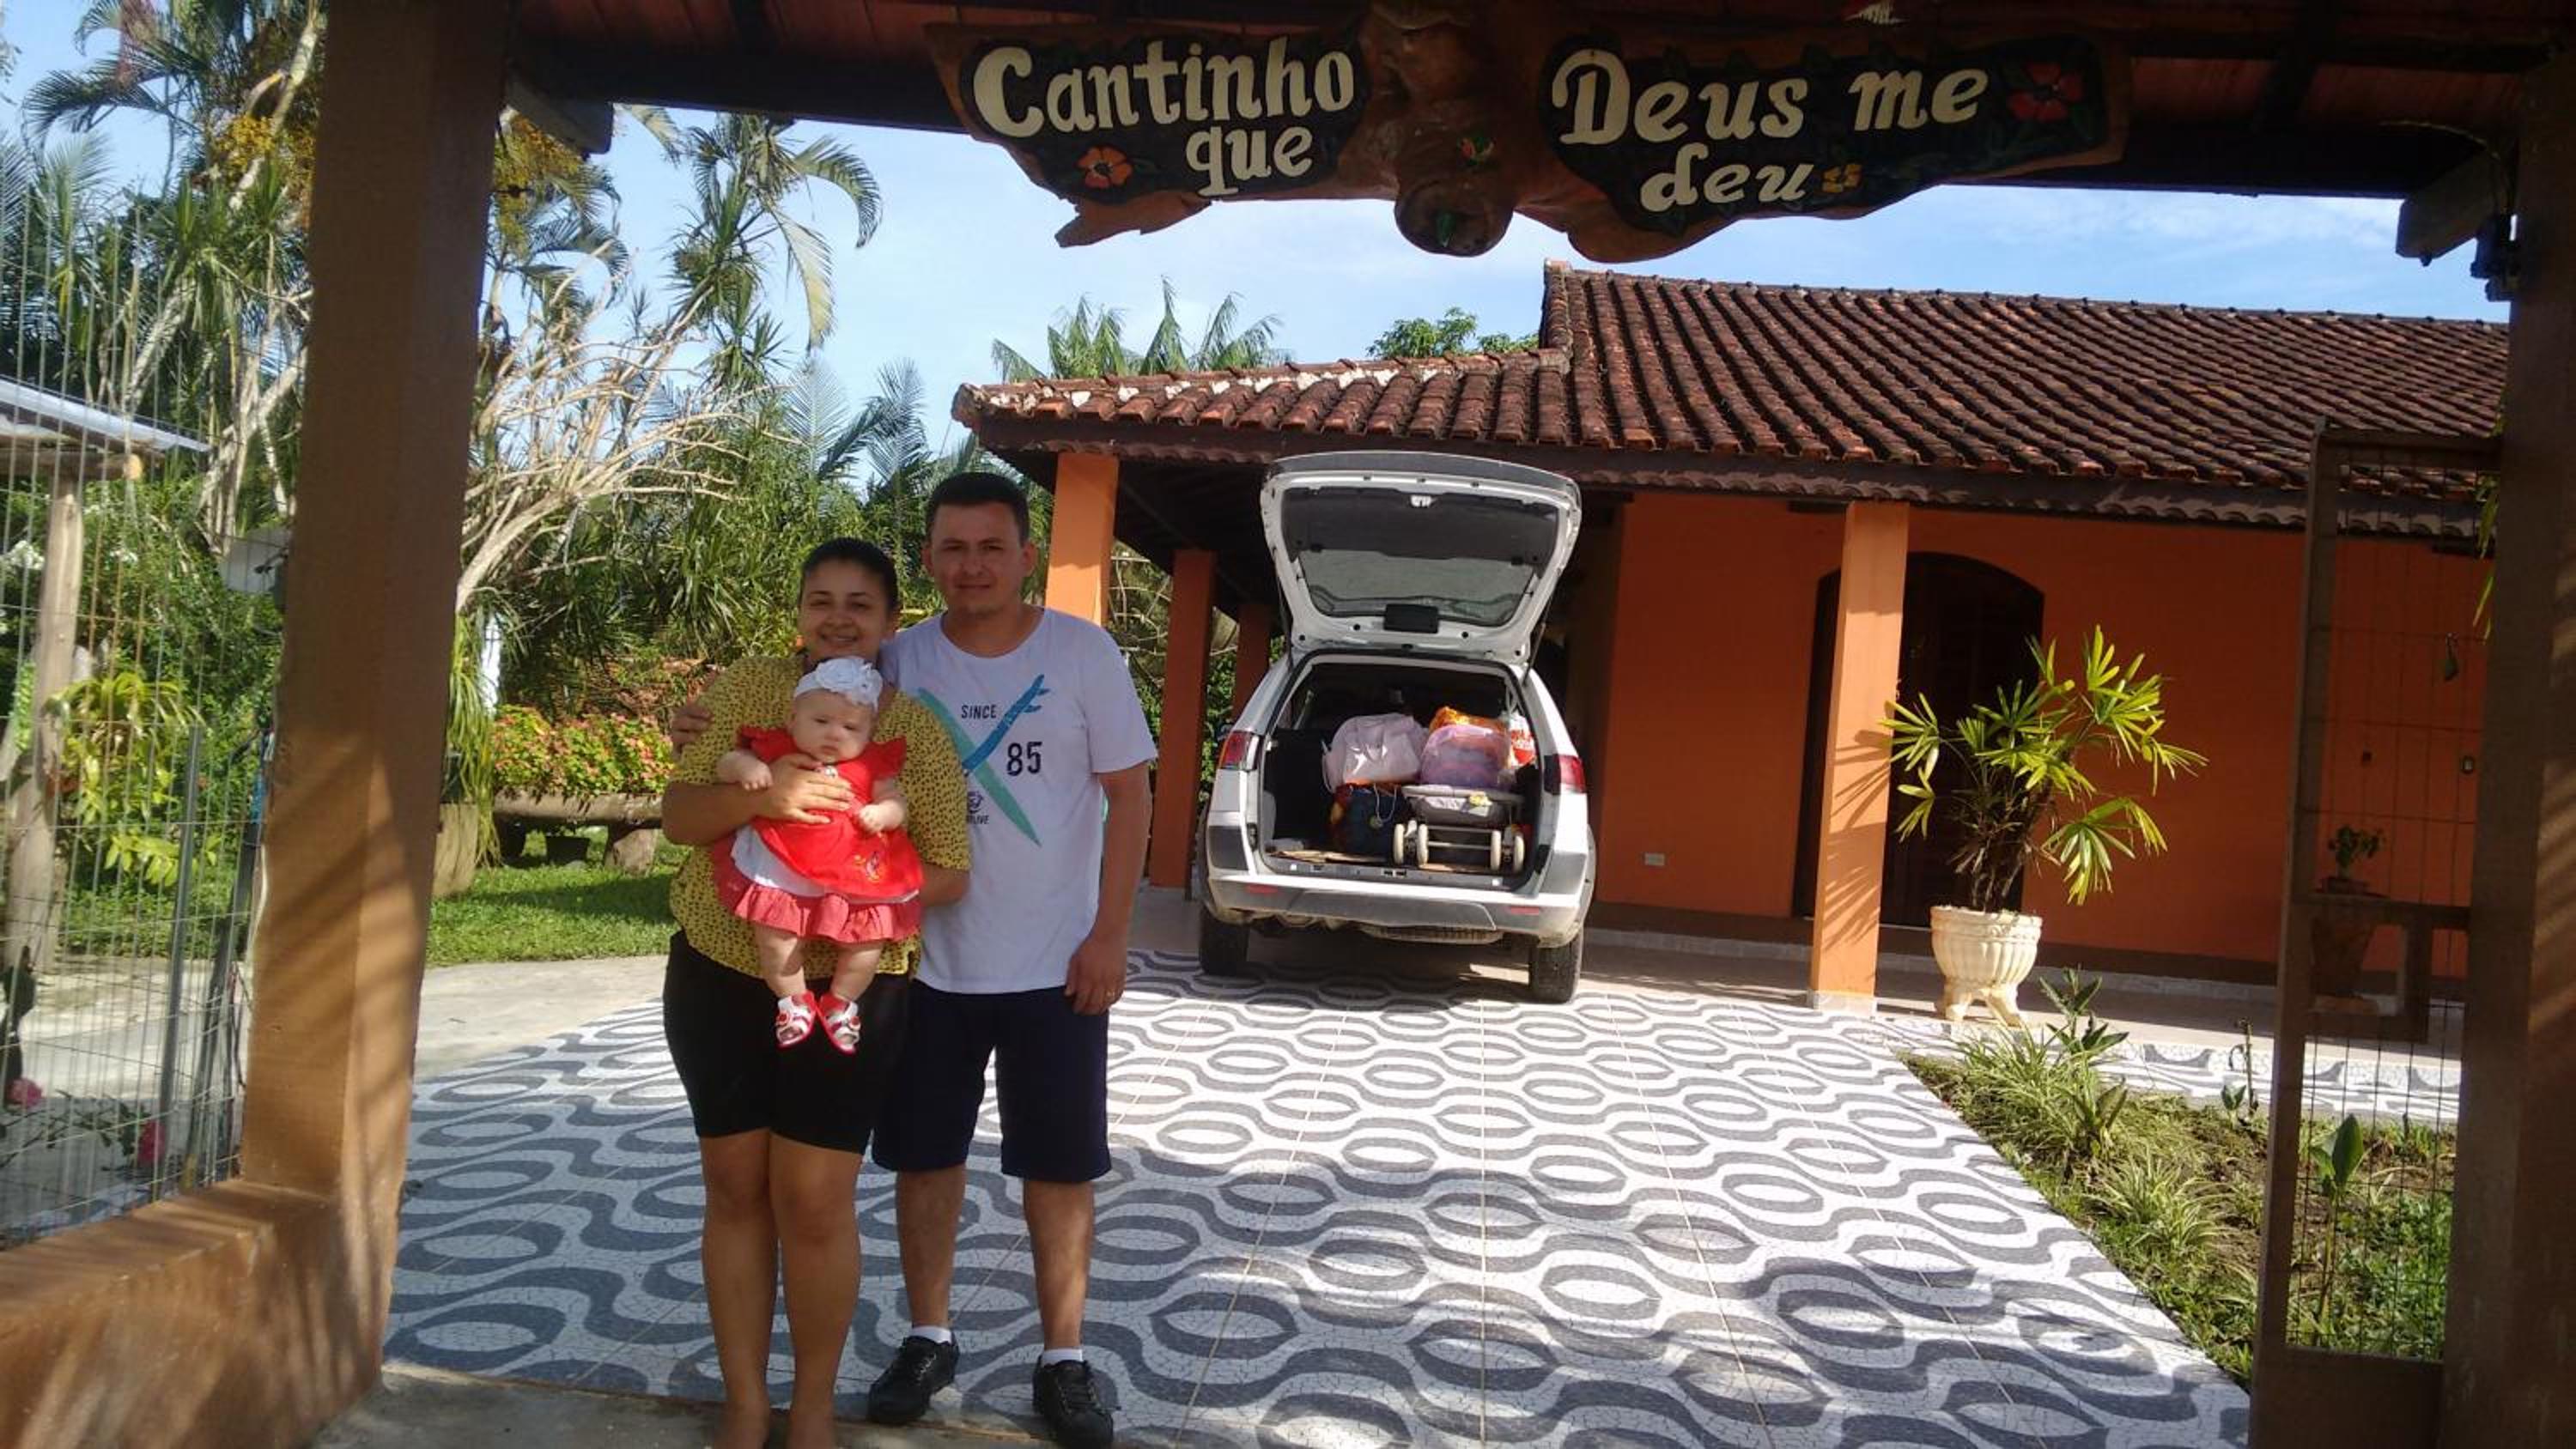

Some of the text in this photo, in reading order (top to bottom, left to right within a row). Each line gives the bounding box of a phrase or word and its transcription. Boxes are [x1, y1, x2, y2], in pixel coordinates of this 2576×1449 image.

[973, 37, 1354, 137] Cantinho
[1552, 49, 1989, 144] Deus me
[1186, 126, 1313, 196] que
[1640, 144, 1814, 212] deu
[961, 705, 997, 719] SINCE
[1006, 741, 1042, 776] 85
